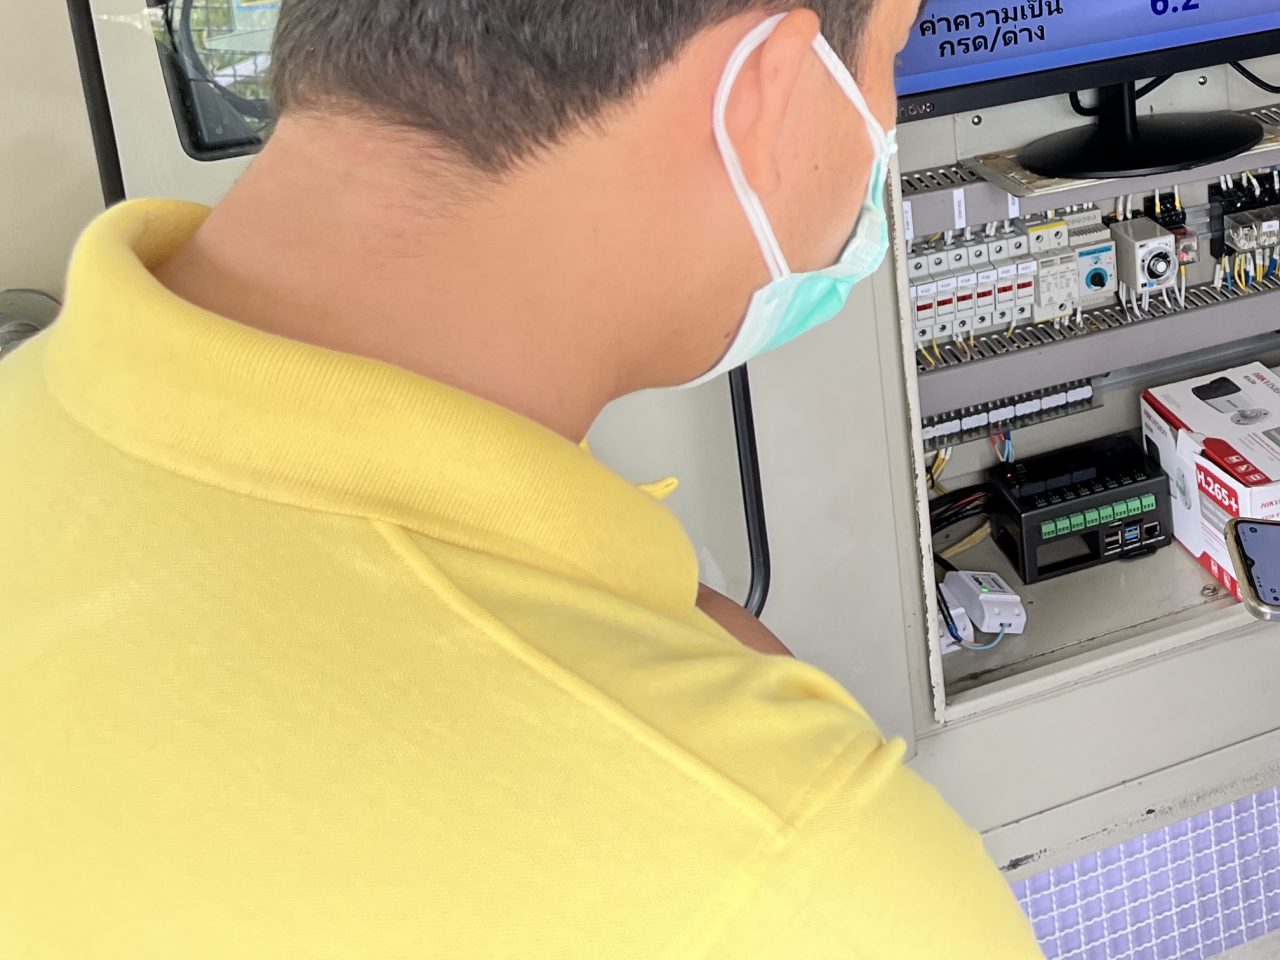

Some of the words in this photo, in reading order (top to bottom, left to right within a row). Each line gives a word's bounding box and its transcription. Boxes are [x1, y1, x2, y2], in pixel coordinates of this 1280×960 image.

[939, 25, 1046, 58] กรด/ด่าง
[1197, 470, 1239, 512] H.265+
